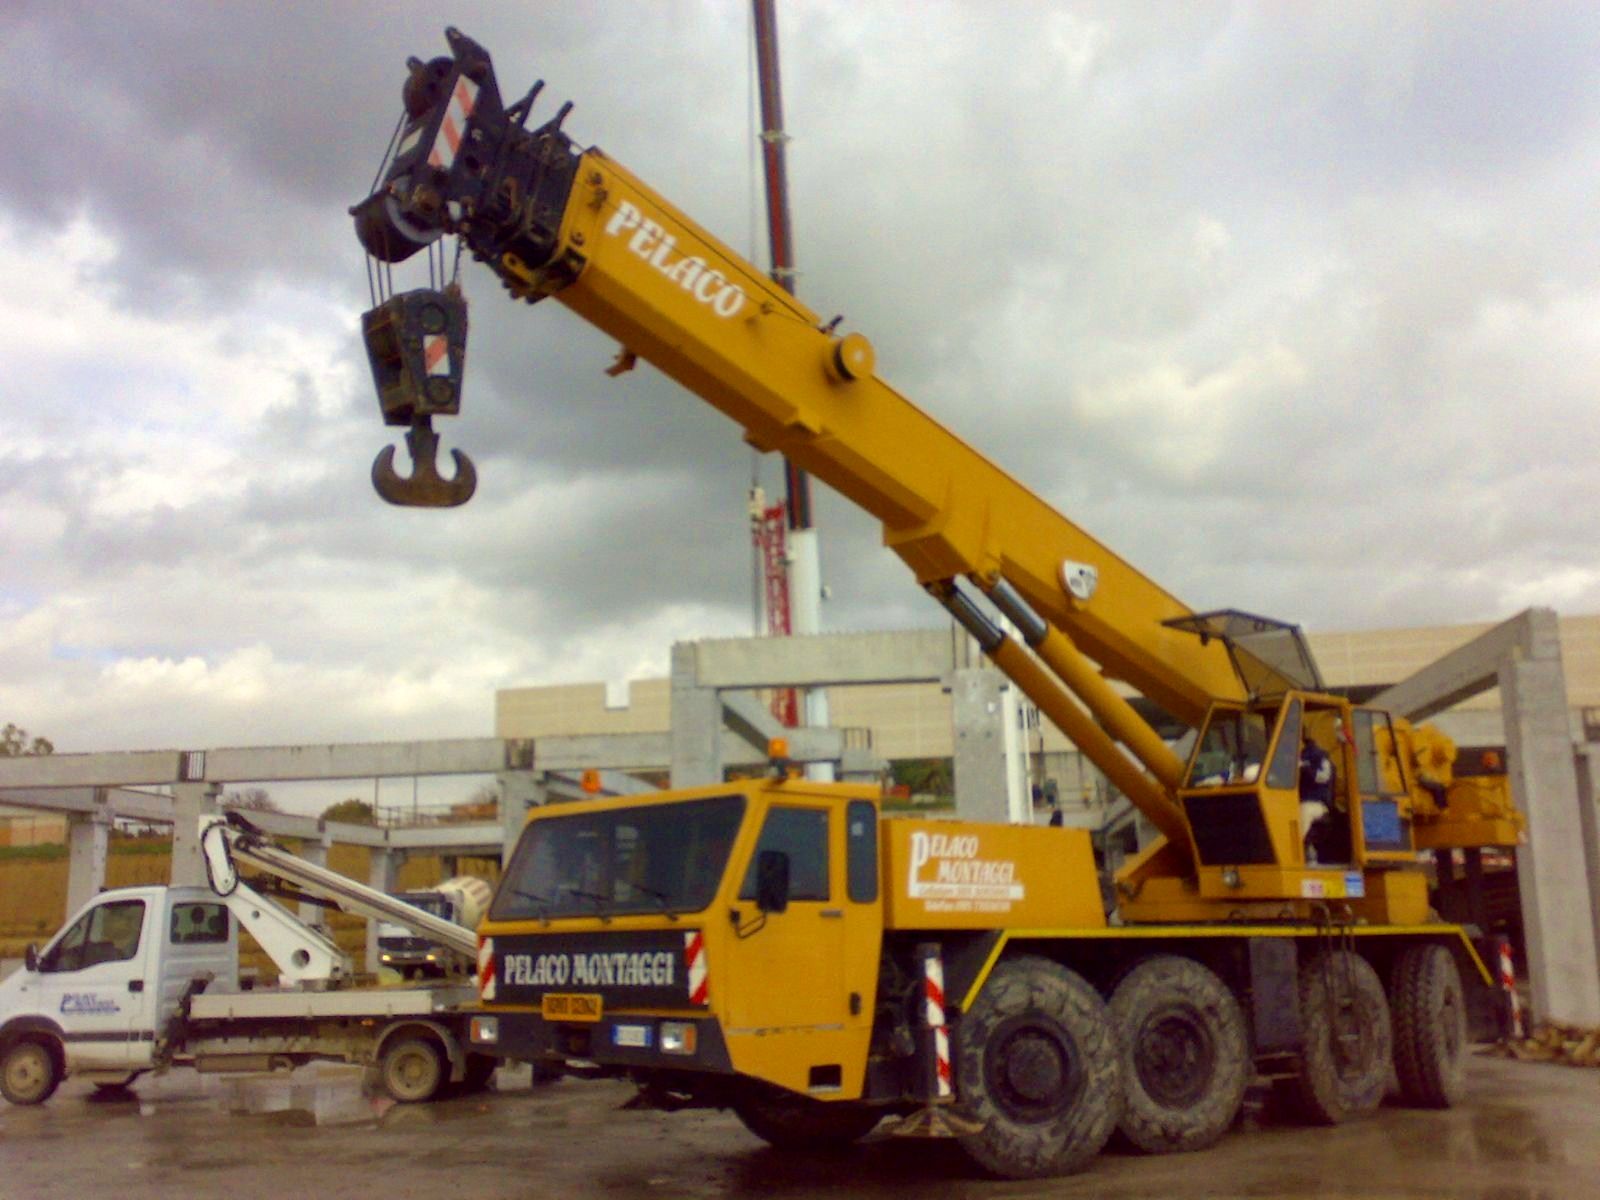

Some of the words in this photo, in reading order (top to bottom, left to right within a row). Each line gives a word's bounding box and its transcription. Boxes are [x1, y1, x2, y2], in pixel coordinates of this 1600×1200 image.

[605, 200, 745, 317] PELACO
[910, 831, 978, 882] PELACO
[938, 860, 1014, 883] MONTAGGI
[504, 953, 570, 985] PELACO
[572, 952, 674, 985] MONTAGGI
